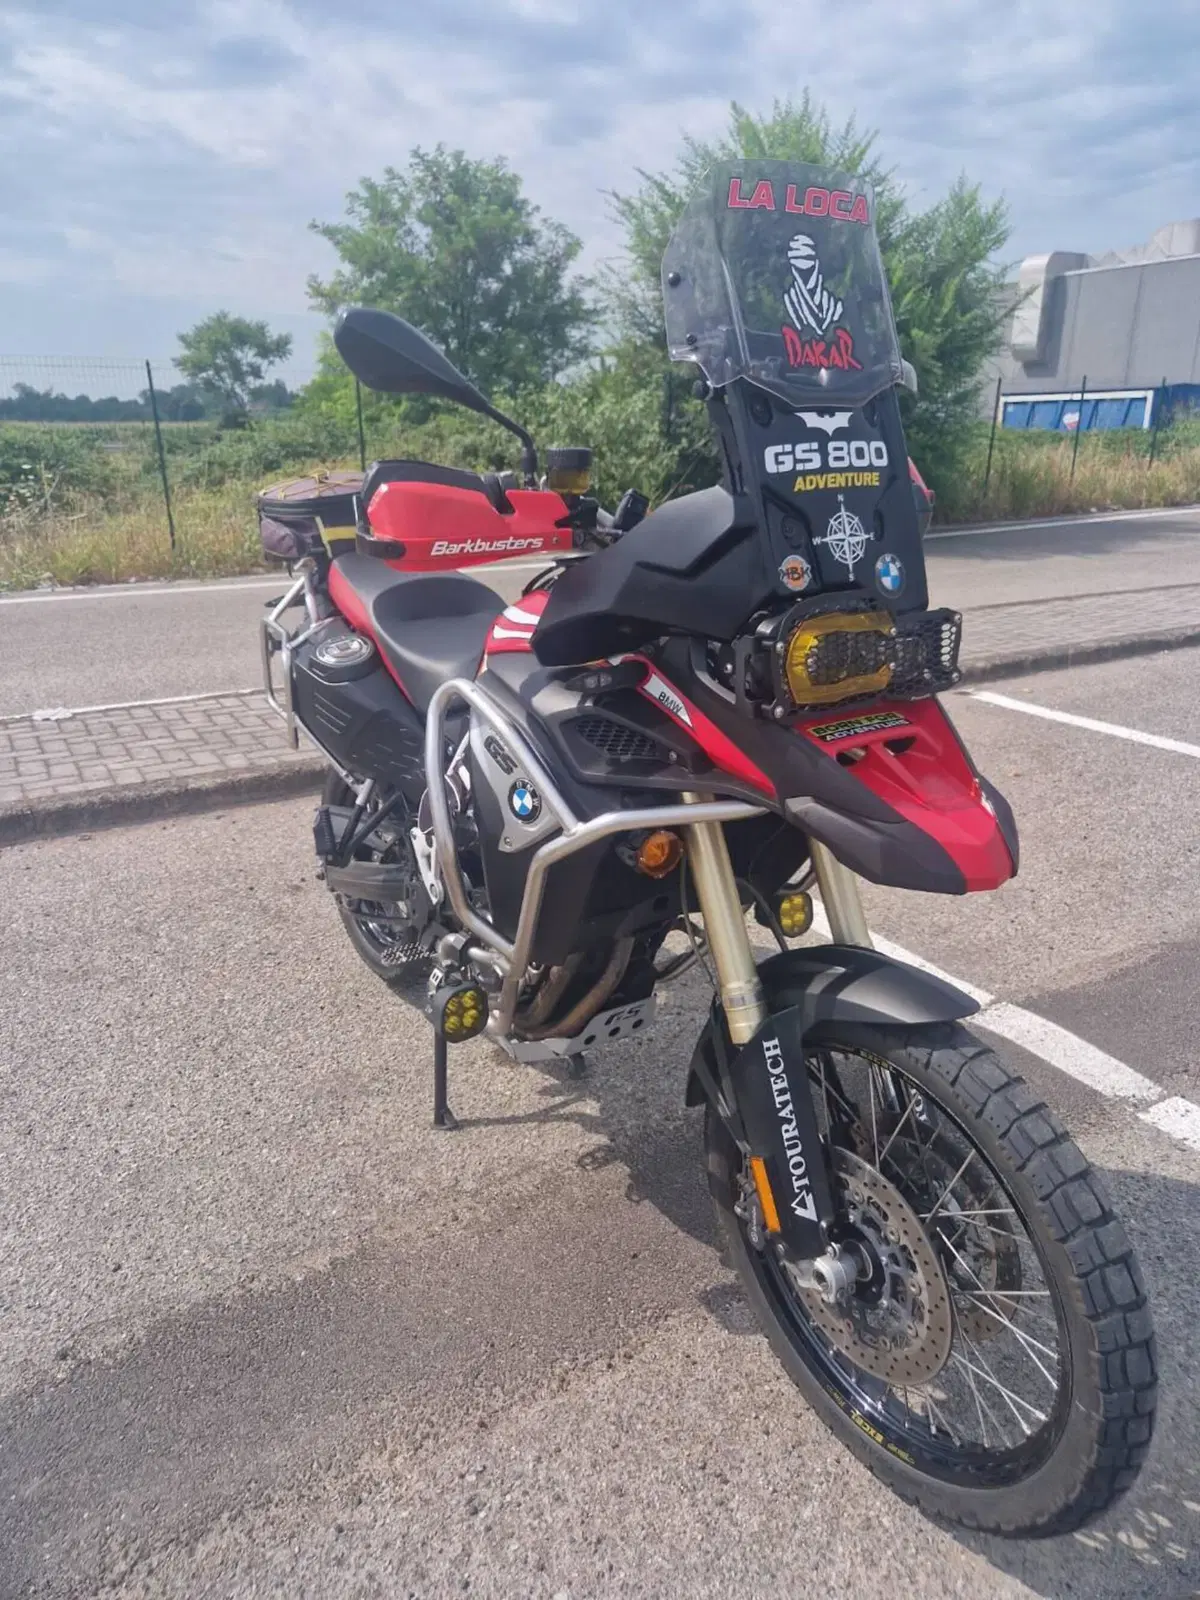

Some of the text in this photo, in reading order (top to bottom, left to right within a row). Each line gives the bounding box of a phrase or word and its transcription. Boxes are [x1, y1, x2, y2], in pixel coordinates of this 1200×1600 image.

[727, 178, 869, 225] LA LOCA
[781, 324, 863, 371] DAKAR
[764, 440, 889, 474] GS 800
[793, 471, 880, 492] ADVENTURE
[430, 536, 544, 556] Barkbusters
[812, 536, 821, 546] W
[658, 690, 683, 715] BMW
[811, 711, 899, 736] BORN FOR
[825, 719, 910, 742] ADVENTURE
[483, 735, 518, 776] GS
[761, 1037, 811, 1194] TOURATECH
